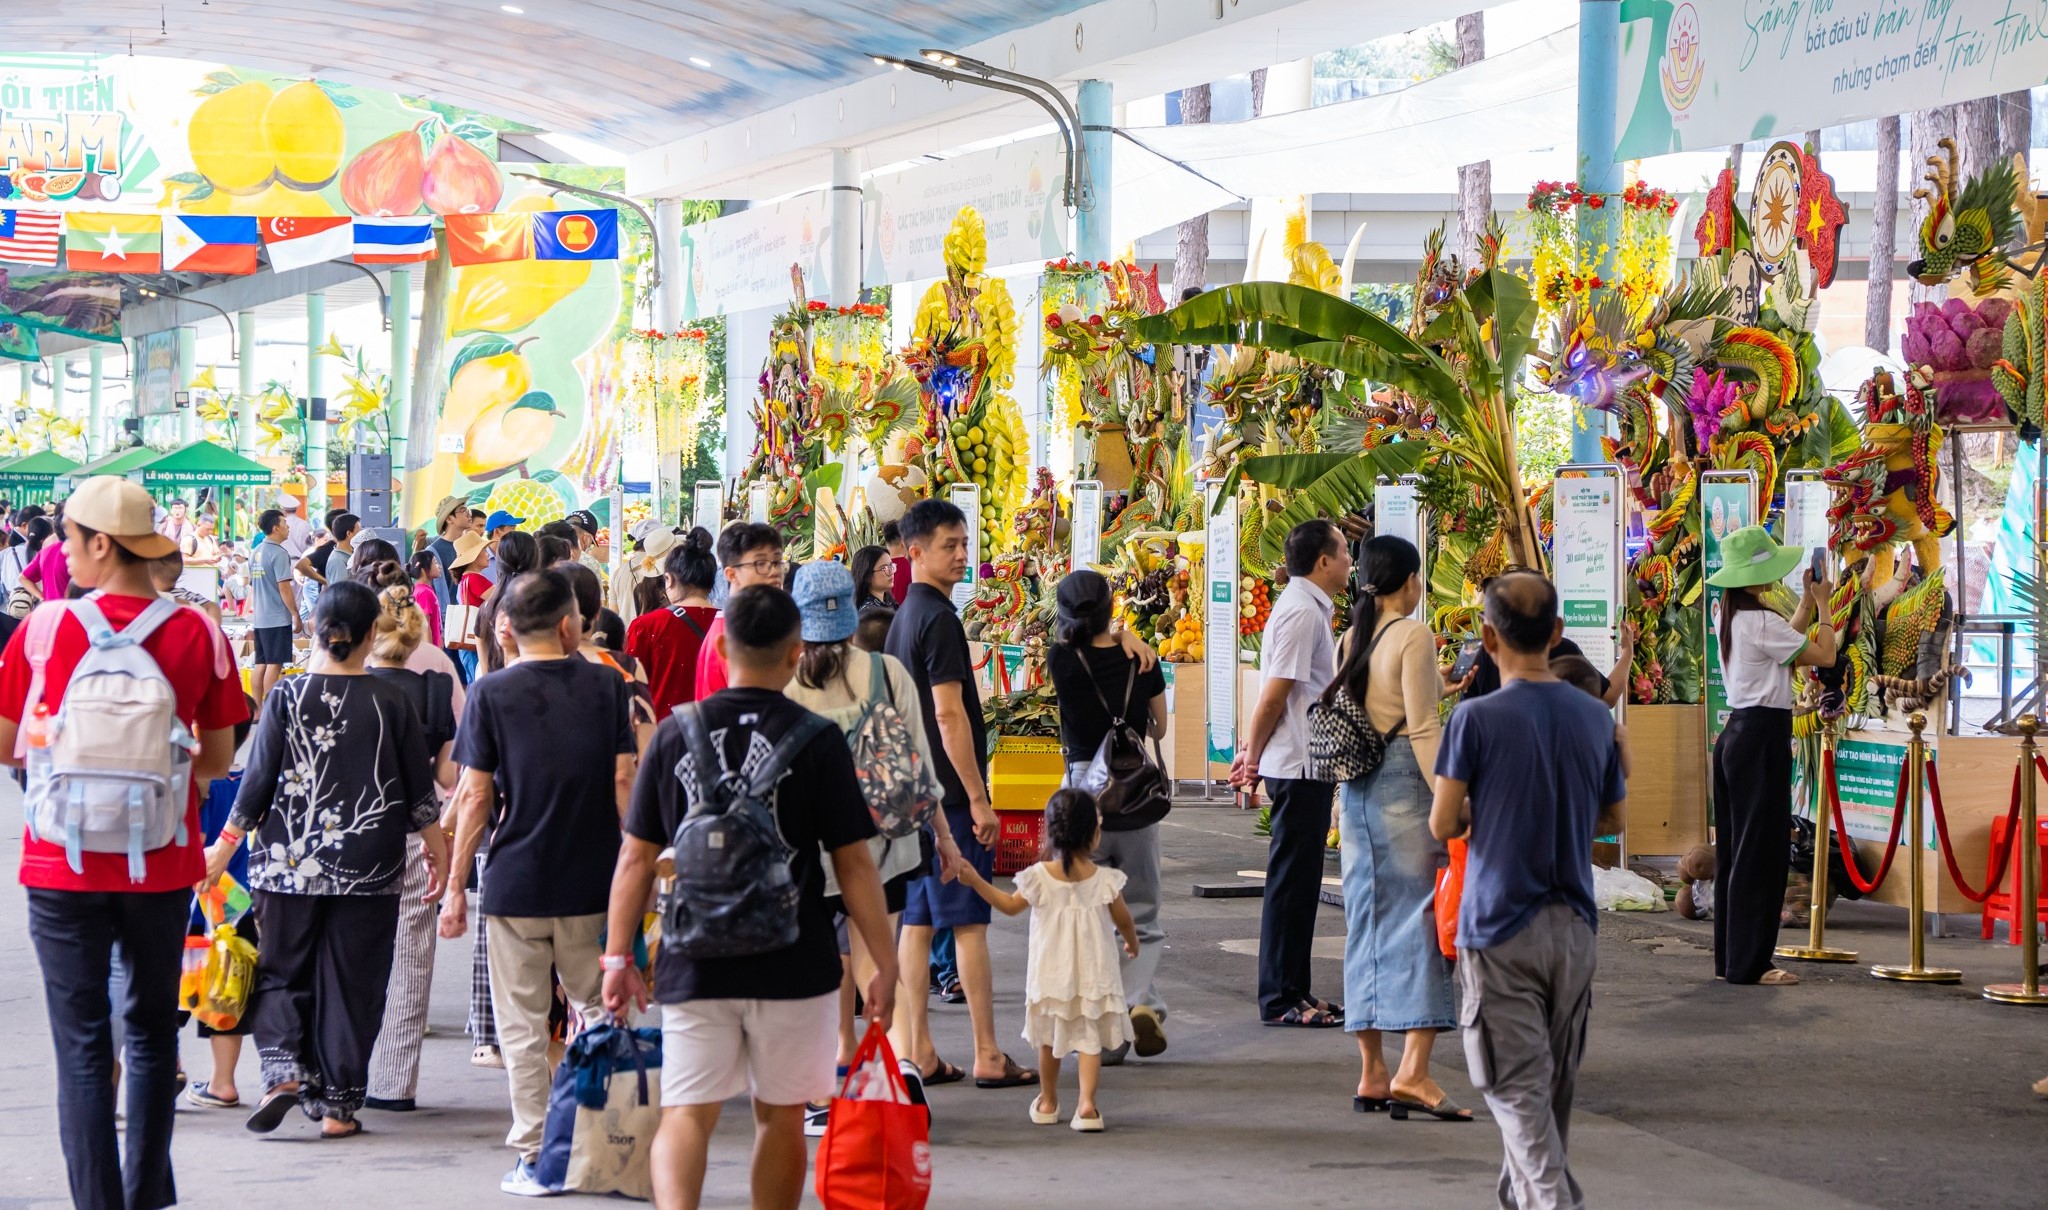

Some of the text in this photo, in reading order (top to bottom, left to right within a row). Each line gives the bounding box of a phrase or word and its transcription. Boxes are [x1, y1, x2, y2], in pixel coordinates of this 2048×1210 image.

[1806, 23, 1826, 53] bắt
[1829, 15, 1852, 46] đầu
[1856, 12, 1870, 36] từ
[1832, 65, 1873, 95] nhưng
[1875, 53, 1910, 83] chạm
[1914, 36, 1937, 69] đến
[43, 74, 114, 113] TIÊN
[23, 473, 38, 481] TRÁI
[39, 473, 53, 481] CÂY
[157, 472, 173, 481] HỘI
[175, 472, 194, 480] TRÁI
[196, 472, 213, 480] CÂY
[236, 472, 248, 482] BỘ
[1849, 750, 1859, 762] TẠO
[1859, 750, 1871, 762] HÌNH
[1872, 750, 1886, 764] BẰNG
[1887, 752, 1898, 765] TRÁI
